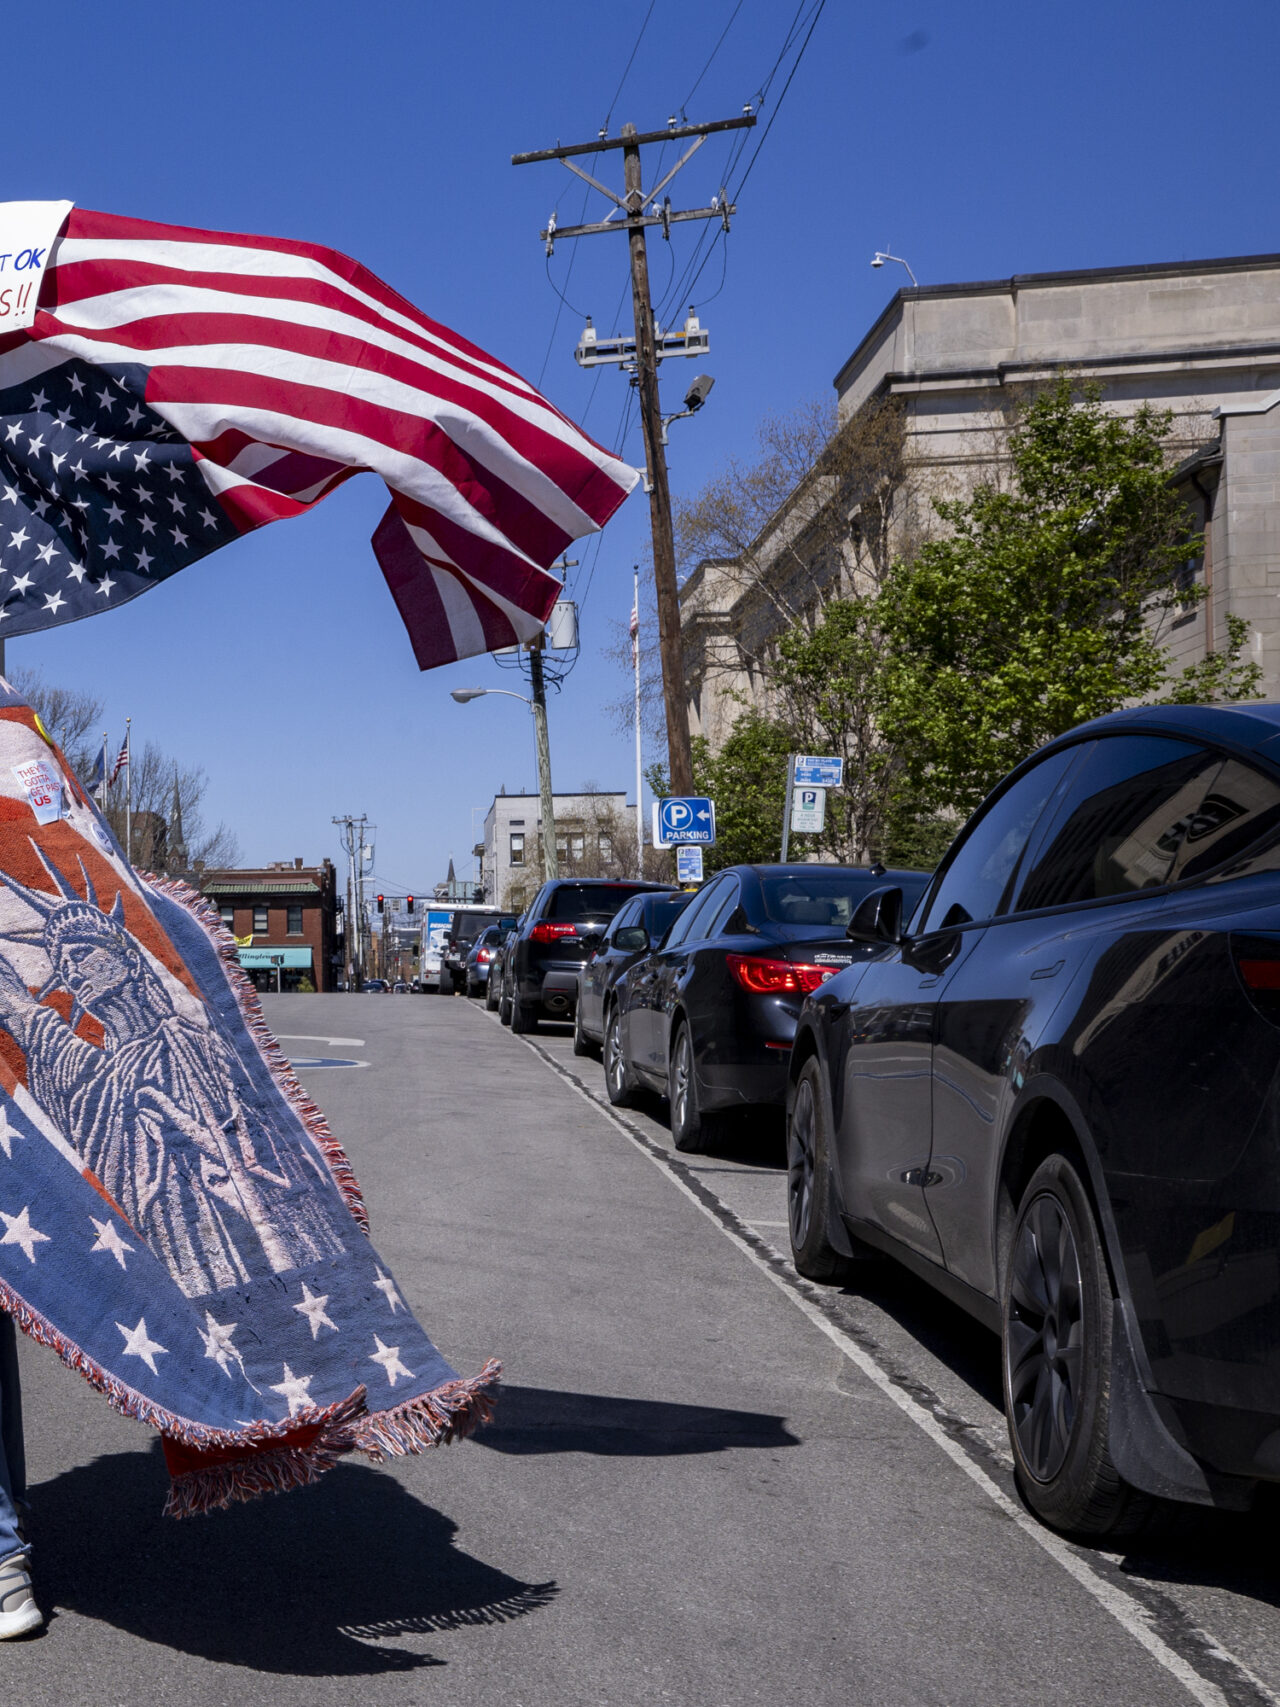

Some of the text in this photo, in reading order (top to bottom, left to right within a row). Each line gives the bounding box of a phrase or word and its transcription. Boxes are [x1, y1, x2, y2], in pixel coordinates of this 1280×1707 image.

[14, 248, 46, 271] OK
[30, 785, 45, 797] GET
[34, 795, 52, 807] US
[671, 805, 688, 826] P
[666, 831, 709, 840] PARKING
